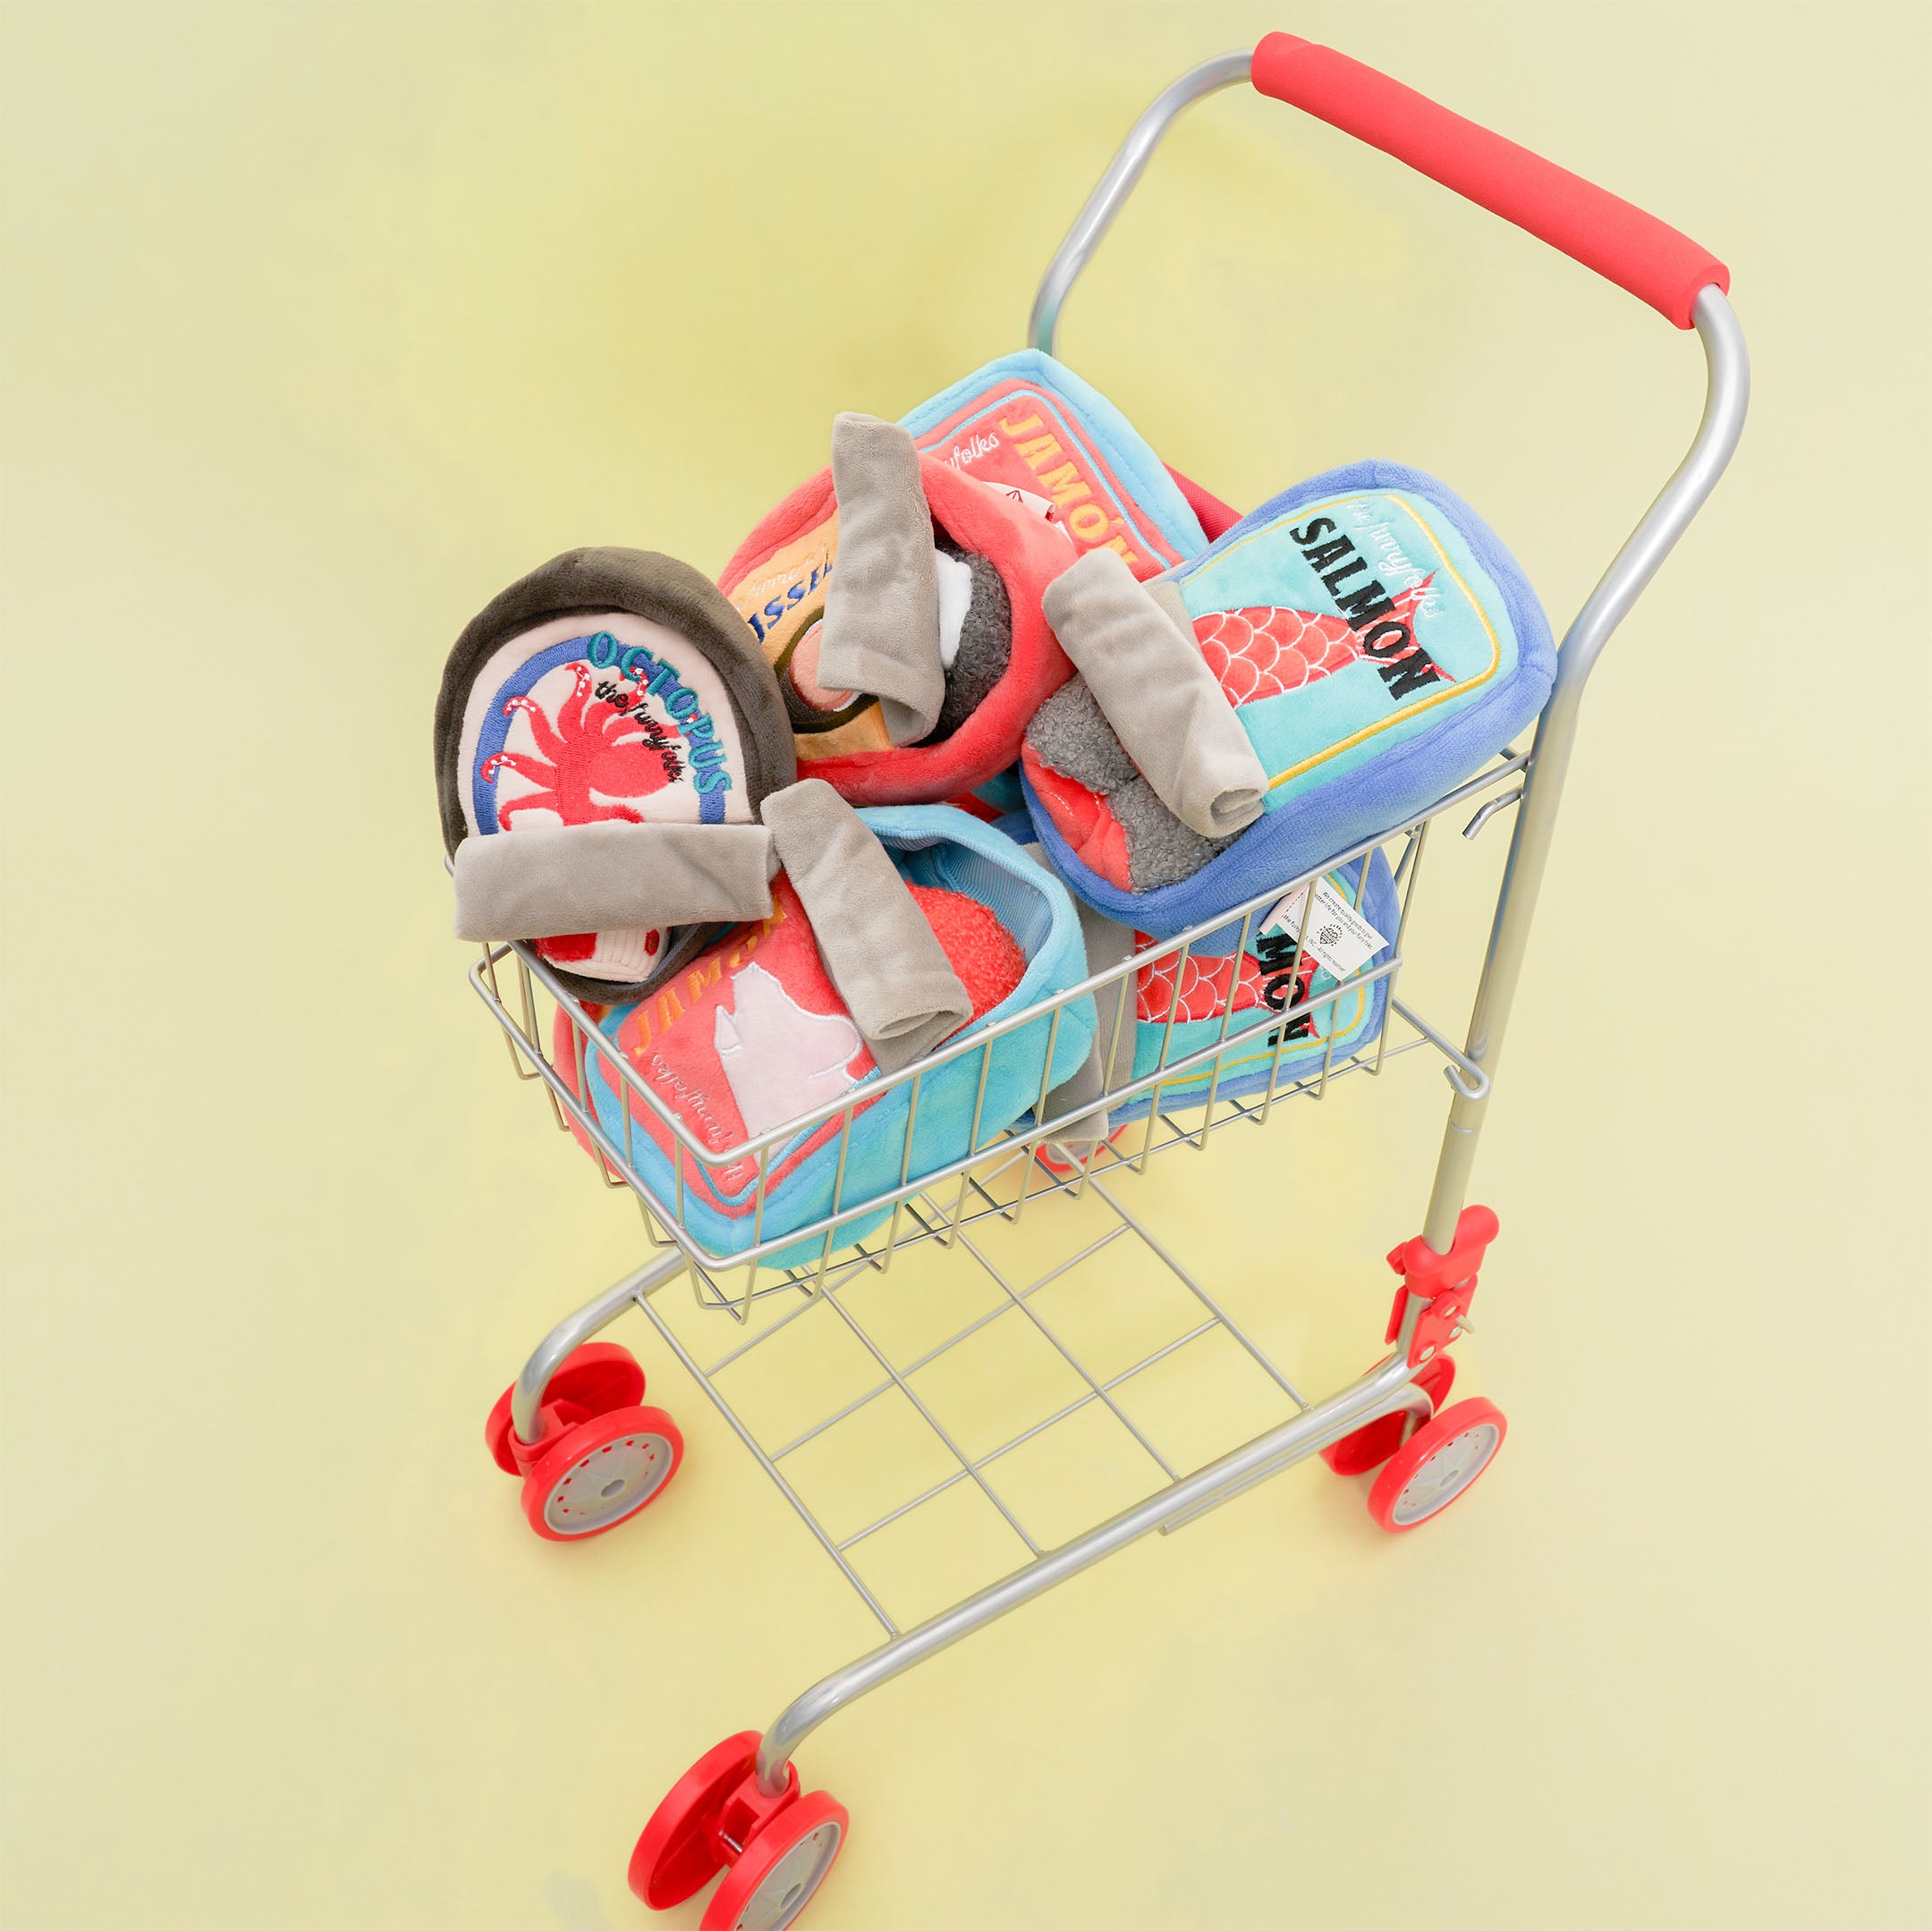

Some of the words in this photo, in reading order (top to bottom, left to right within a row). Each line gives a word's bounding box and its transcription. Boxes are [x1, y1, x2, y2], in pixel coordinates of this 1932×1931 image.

[594, 672, 630, 707] the
[1289, 517, 1441, 701] SALMON
[587, 631, 733, 795] OCTOPUS
